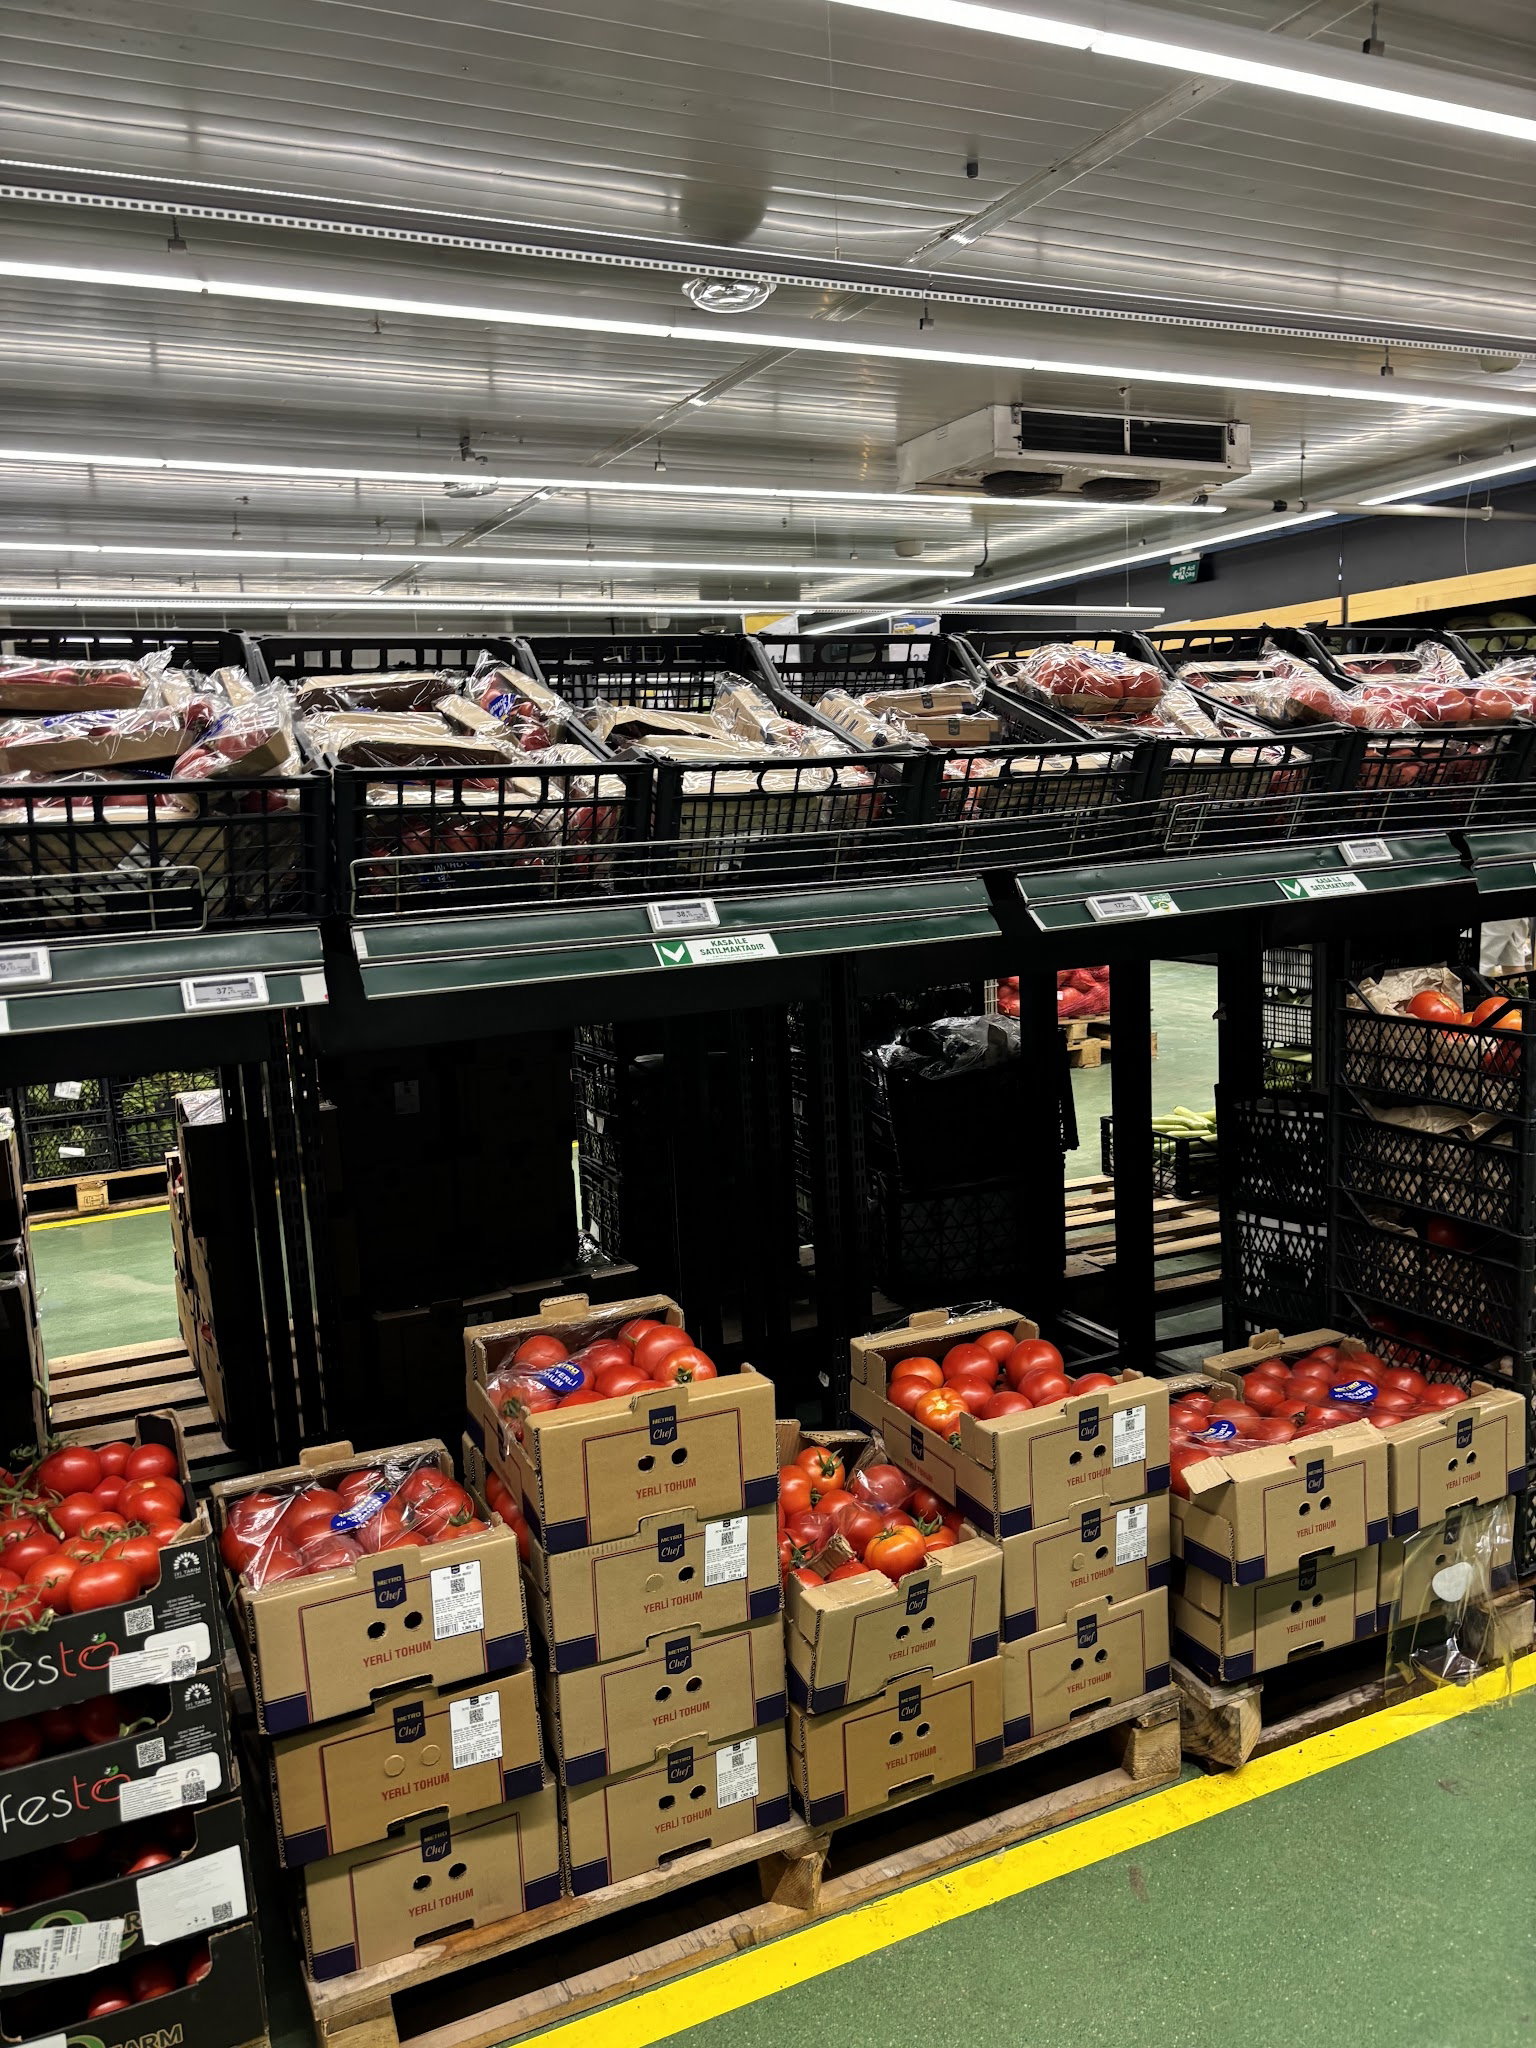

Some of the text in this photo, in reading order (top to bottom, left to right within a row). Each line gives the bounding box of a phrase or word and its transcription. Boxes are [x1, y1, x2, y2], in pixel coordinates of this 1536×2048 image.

[1310, 880, 1357, 891] SATILMAKTADIR
[710, 936, 748, 947] KASA İLE
[700, 943, 766, 956] SATILMAKTADIR
[652, 1416, 674, 1425] METRO
[653, 1426, 675, 1440] Chef
[1081, 1424, 1097, 1436] Chef
[1067, 1467, 1112, 1487] YERLİ TOHUM
[1462, 1471, 1481, 1484] TOHUM
[636, 1478, 697, 1500] YERLİ TOHUM
[1084, 1526, 1099, 1538] Chef
[1296, 1520, 1336, 1538] YERLİ TOHUM
[660, 1533, 682, 1543] METRO
[662, 1544, 682, 1558] Chef
[377, 1575, 402, 1586] METRO
[1071, 1566, 1114, 1588] YERLİ TOHUM
[379, 1588, 403, 1603] Chef
[644, 1591, 703, 1614] YERLİ TOHUM
[908, 1598, 926, 1610] Chef
[1080, 1632, 1096, 1644] Chef
[363, 1640, 432, 1668] YERLİ TOHUM
[668, 1646, 689, 1656] METRO
[888, 1638, 937, 1662] YERLİ TOHUM
[668, 1656, 689, 1670] Chef
[1067, 1672, 1112, 1694] YERLİ TOHUM
[396, 1712, 421, 1722] METRO
[652, 1701, 710, 1726] YERLİ TOHUM
[901, 1704, 920, 1716] Chef
[398, 1723, 422, 1738] Chef
[670, 1755, 692, 1766] METRO
[886, 1745, 936, 1770] YERLİ TOHUM
[670, 1765, 692, 1780] Chef
[381, 1772, 450, 1801] YERLİ TOHUM
[654, 1808, 712, 1834] YERLİ TOHUM
[424, 1831, 448, 1842] METRO
[426, 1842, 449, 1857] Chef
[408, 1888, 474, 1918] YERLİ TOHUM
